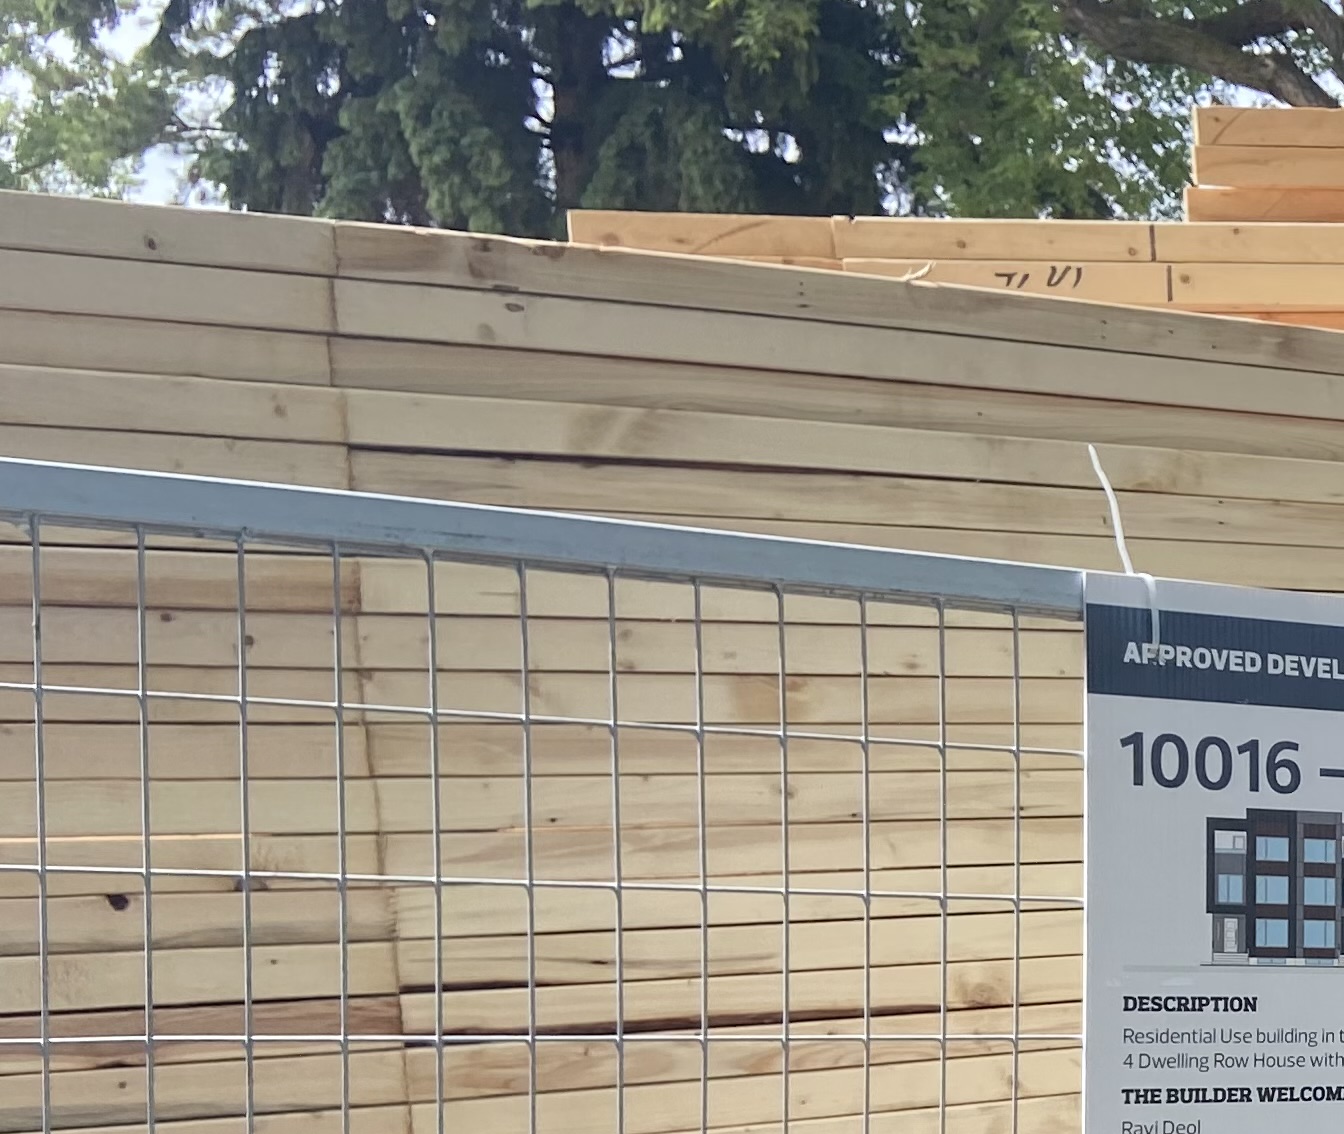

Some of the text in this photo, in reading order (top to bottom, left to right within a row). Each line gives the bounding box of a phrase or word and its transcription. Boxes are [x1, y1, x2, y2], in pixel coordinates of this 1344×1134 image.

[1123, 642, 1262, 673] APPROVED
[1120, 731, 1302, 794] 10016
[1122, 996, 1258, 1012] DESCRIPTION
[1122, 1028, 1217, 1044] Residential
[1220, 1028, 1252, 1044] Use
[1256, 1028, 1318, 1047] building
[1321, 1028, 1335, 1043] in
[1122, 1053, 1134, 1069] 4
[1138, 1053, 1210, 1072] Dwelling
[1213, 1053, 1249, 1068] Row
[1253, 1052, 1306, 1068] House
[1310, 1052, 1344, 1067] with
[1121, 1088, 1162, 1105] THE
[1165, 1087, 1253, 1104] BUILDER
